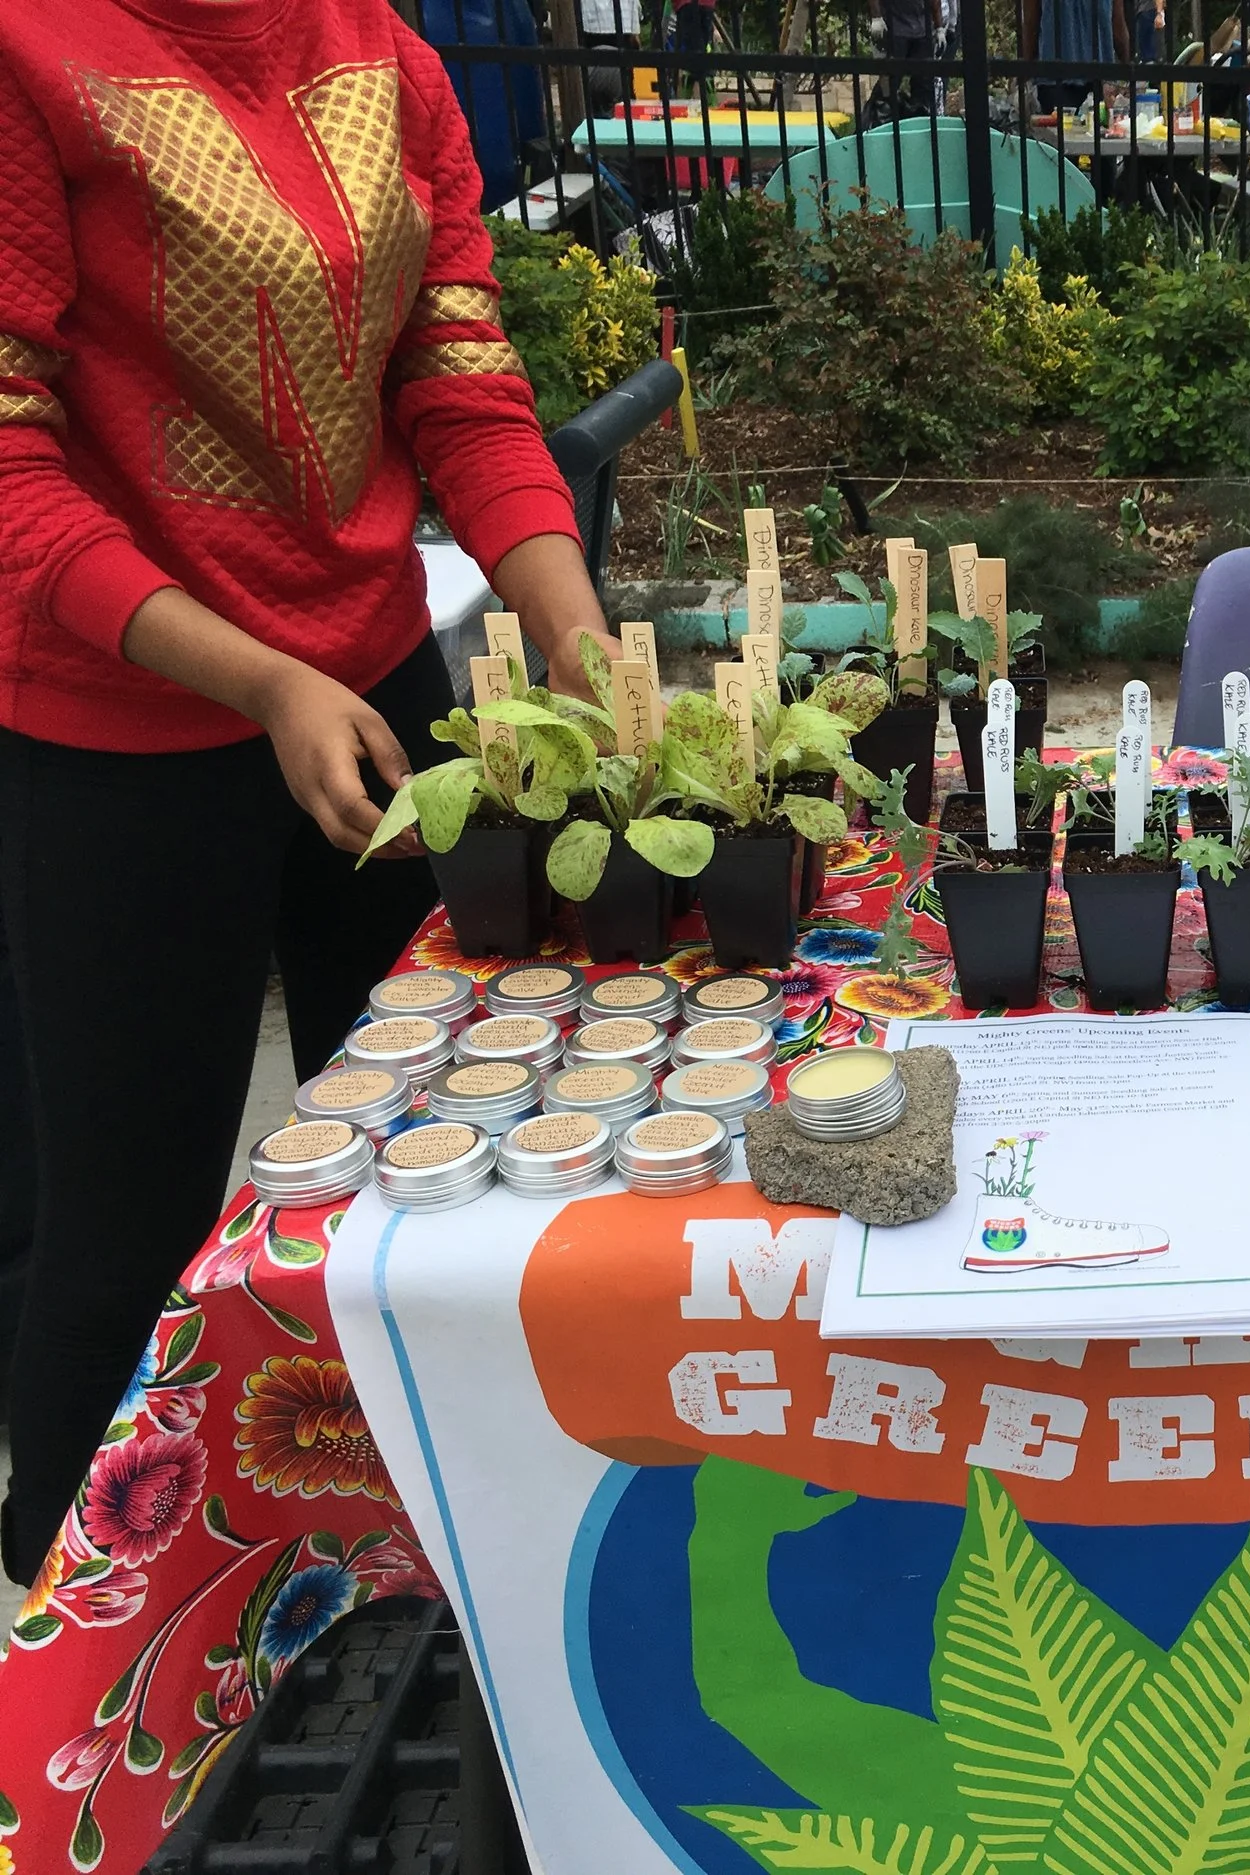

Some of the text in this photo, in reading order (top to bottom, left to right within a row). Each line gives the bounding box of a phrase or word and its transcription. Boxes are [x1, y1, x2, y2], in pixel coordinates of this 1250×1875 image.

[908, 555, 923, 612] Dinosaur
[987, 731, 997, 759] KALE
[999, 728, 1008, 747] RED
[977, 1031, 1022, 1039] Mighty
[1079, 1027, 1144, 1036] Upcoming
